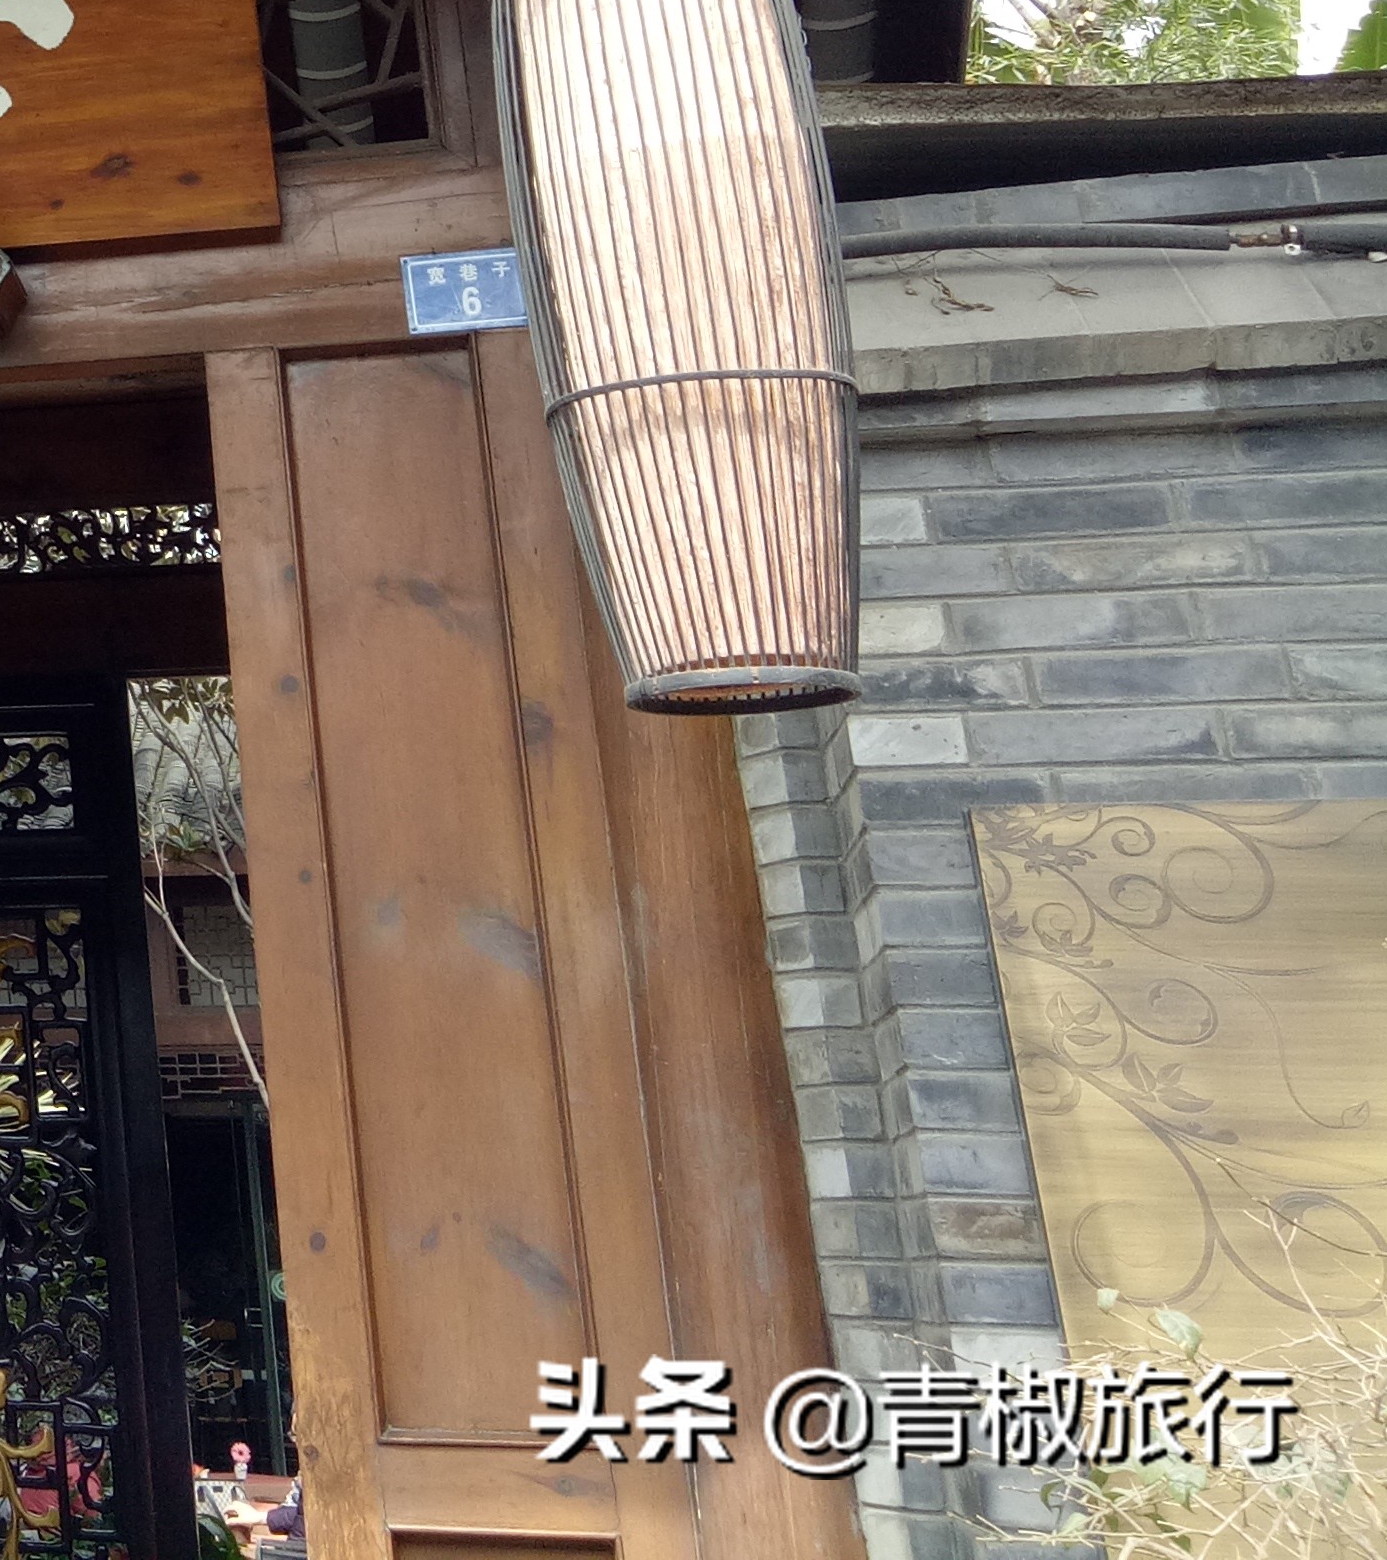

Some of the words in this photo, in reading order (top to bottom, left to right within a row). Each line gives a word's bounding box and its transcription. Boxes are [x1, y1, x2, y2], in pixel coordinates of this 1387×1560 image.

[426, 260, 511, 286] 宽巷子
[461, 286, 482, 317] 6
